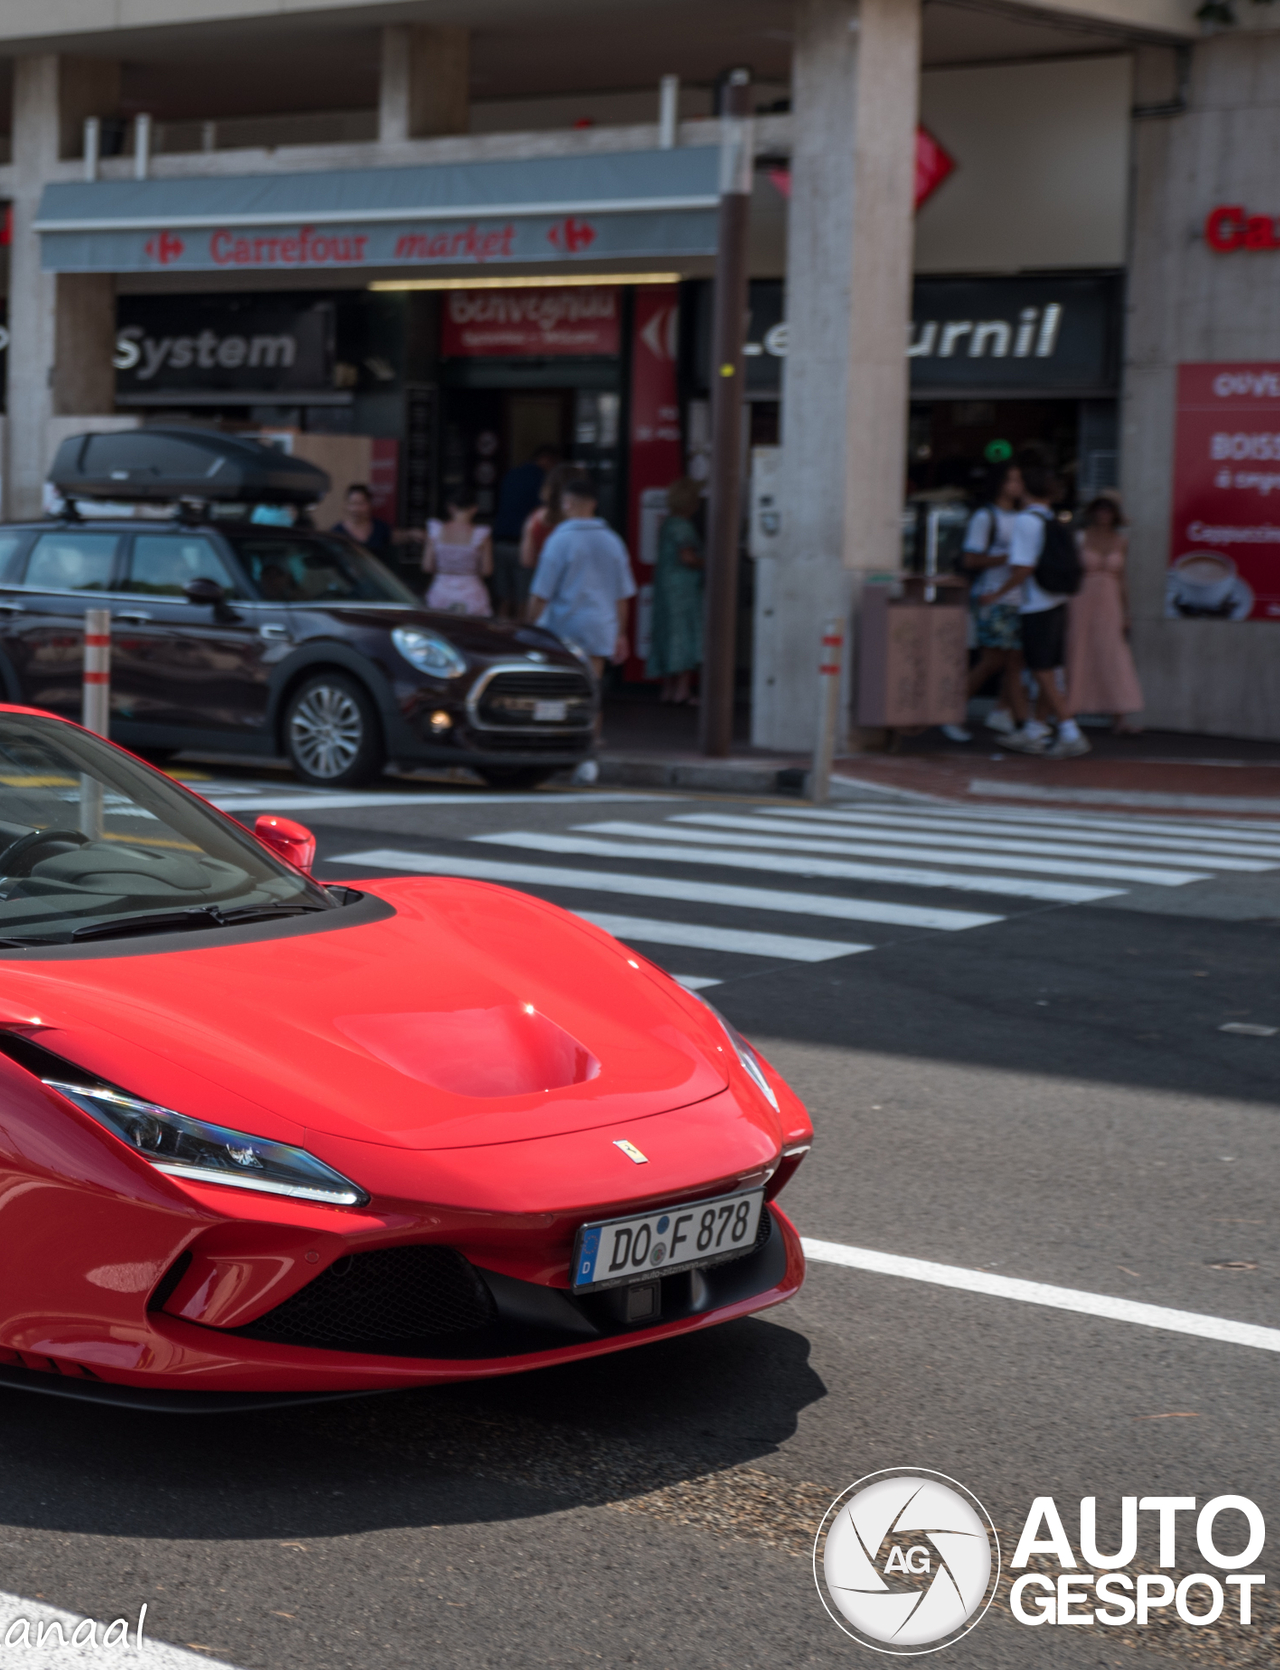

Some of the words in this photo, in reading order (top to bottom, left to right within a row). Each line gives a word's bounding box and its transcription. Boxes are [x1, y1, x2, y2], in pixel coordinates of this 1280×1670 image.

[209, 225, 368, 265] Carrefour
[394, 221, 516, 264] market
[1204, 203, 1280, 253] Ca
[111, 325, 297, 380] System
[903, 303, 1061, 357] urnil
[1212, 371, 1280, 397] OUVE
[608, 1223, 651, 1272] DO
[669, 1213, 693, 1259] F
[696, 1200, 750, 1251] 878
[581, 1262, 591, 1274] D
